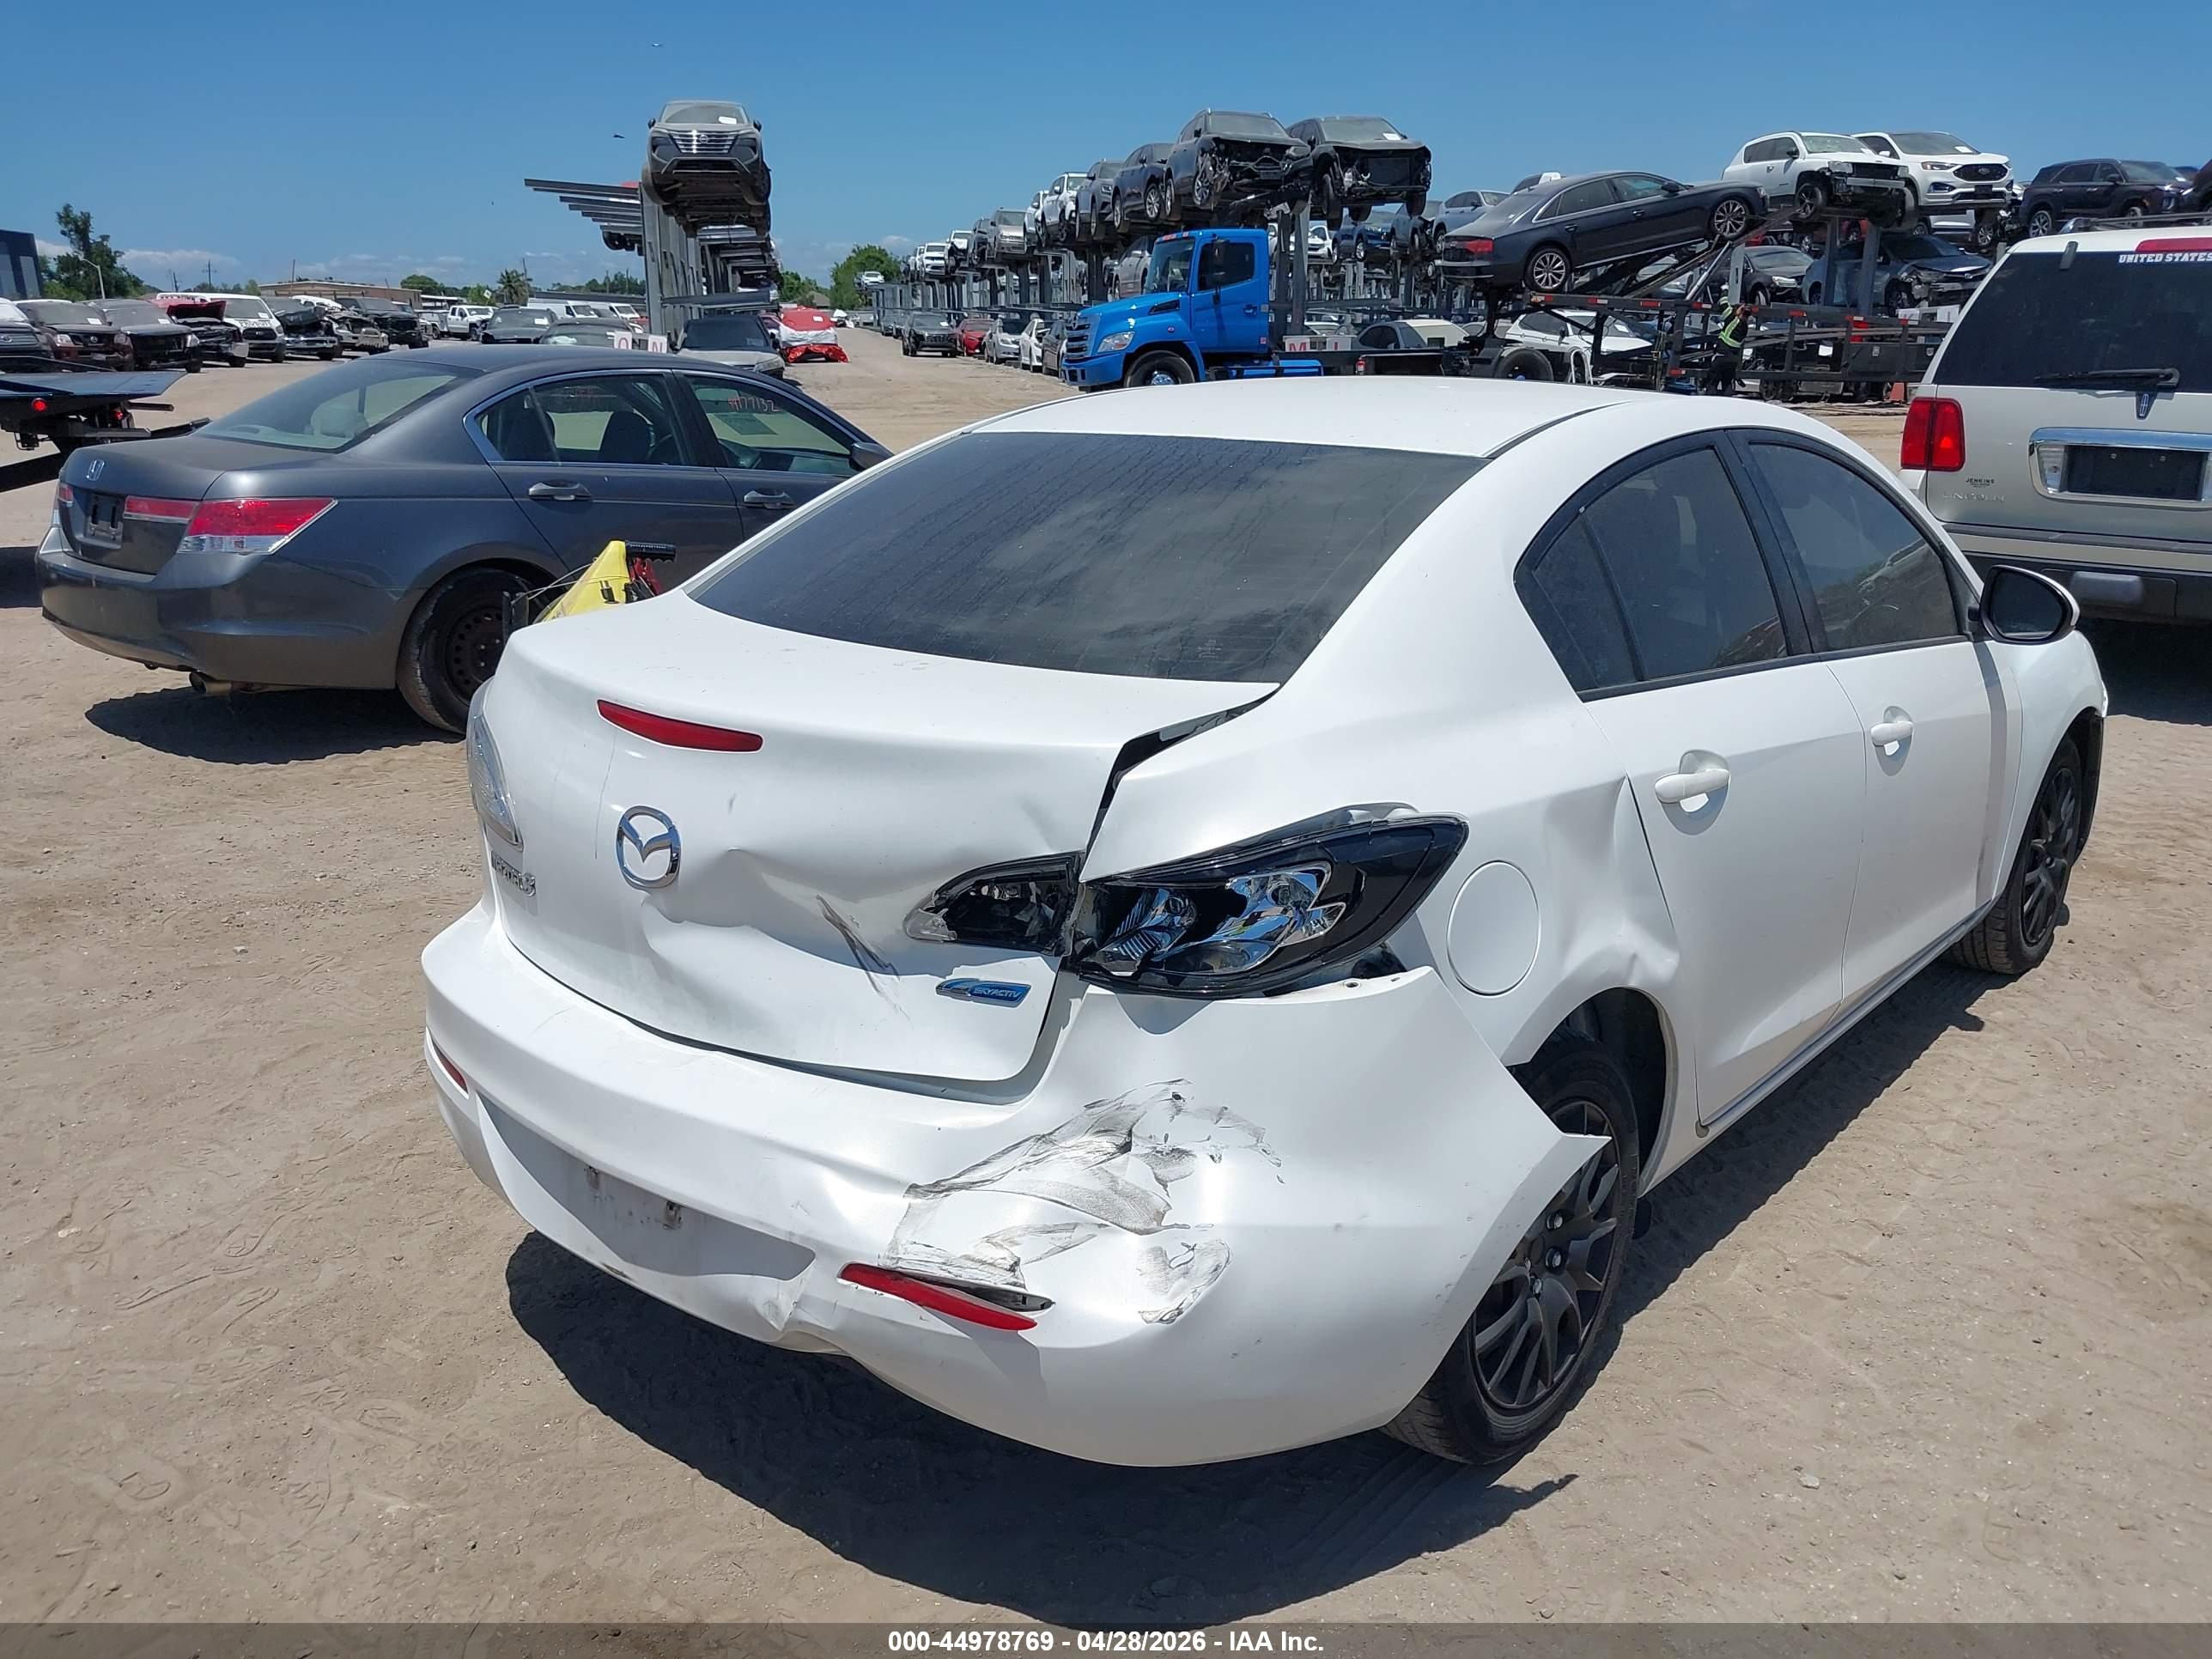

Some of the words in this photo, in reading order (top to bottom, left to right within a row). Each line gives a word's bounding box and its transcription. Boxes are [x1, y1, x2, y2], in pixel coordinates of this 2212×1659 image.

[2118, 254, 2163, 263] UNITED
[2164, 252, 2212, 262] STATES
[974, 988, 1021, 998] SKYACTIV
